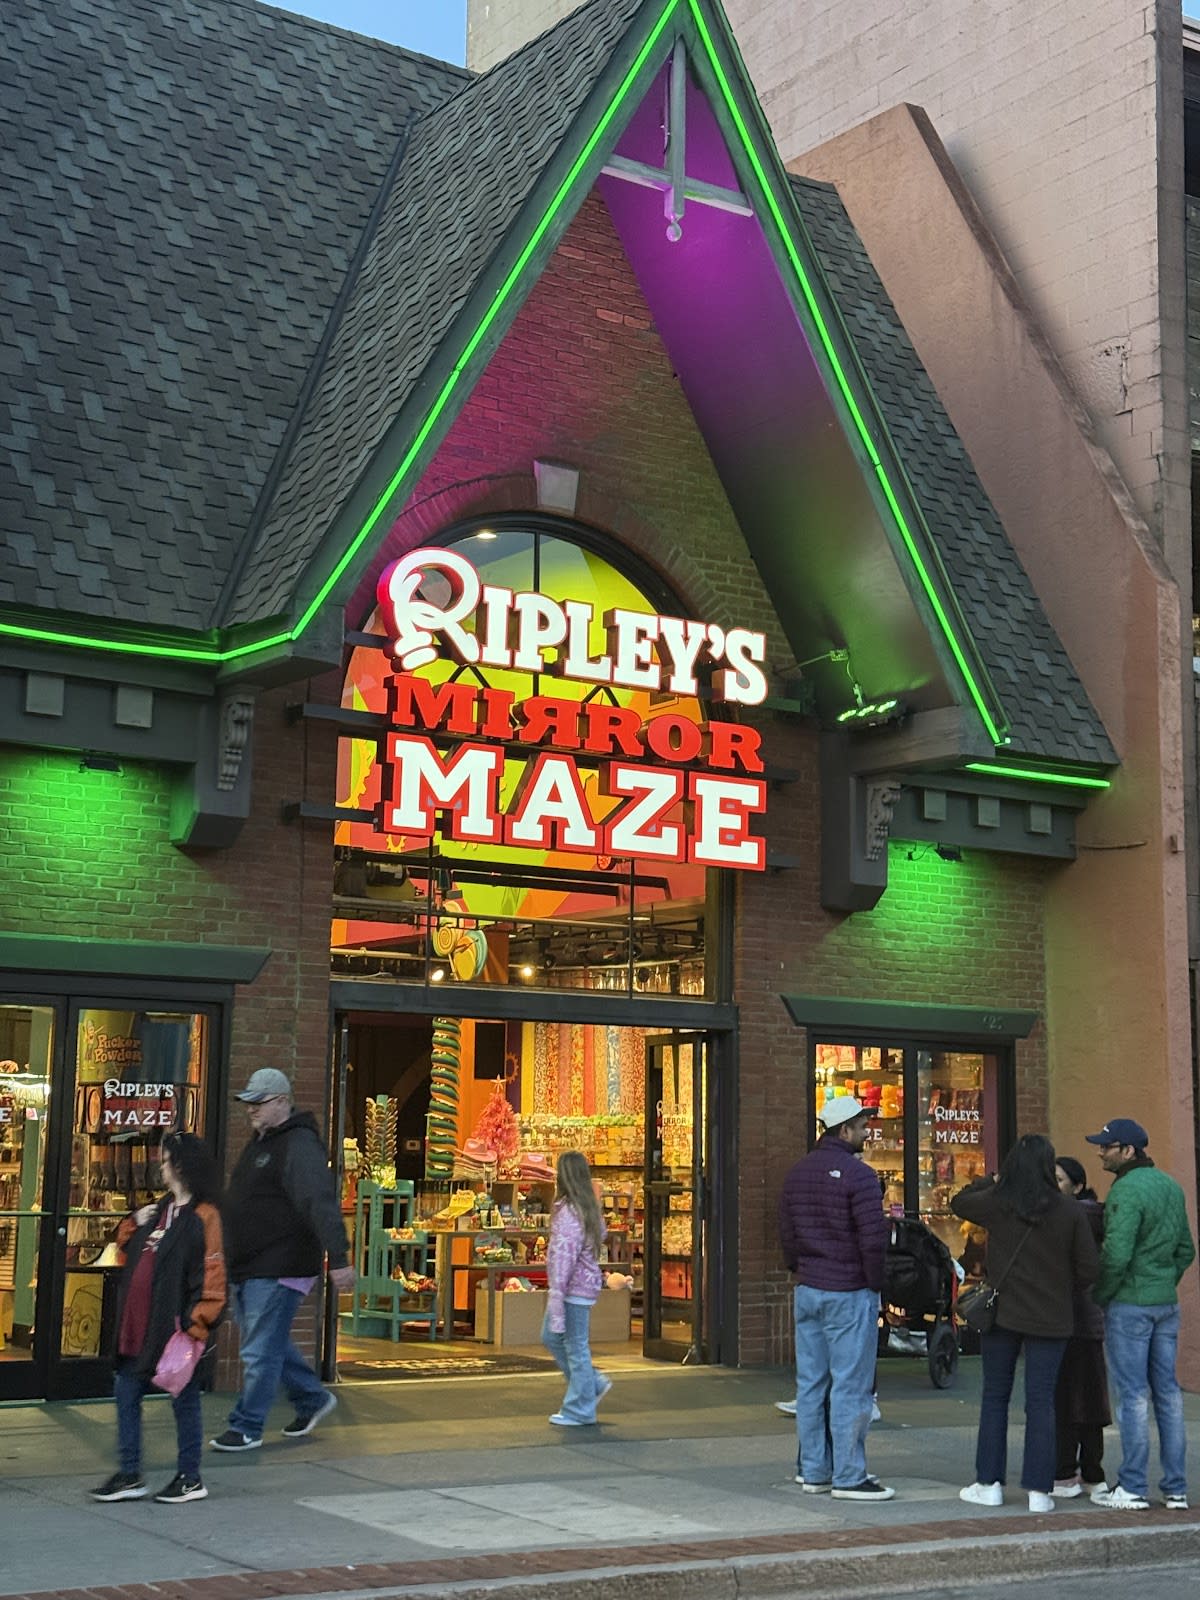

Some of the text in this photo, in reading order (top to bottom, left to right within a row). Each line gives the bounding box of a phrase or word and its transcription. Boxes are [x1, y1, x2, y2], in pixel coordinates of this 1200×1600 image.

[380, 547, 767, 705] RIPLEY'S
[391, 674, 764, 773] MIRROR
[384, 732, 766, 871] MAZE
[104, 1078, 174, 1099] RIPLEY'S
[104, 1110, 172, 1126] MAZE
[935, 1105, 980, 1122] RIPLEY'S
[936, 1130, 979, 1144] MAZE
